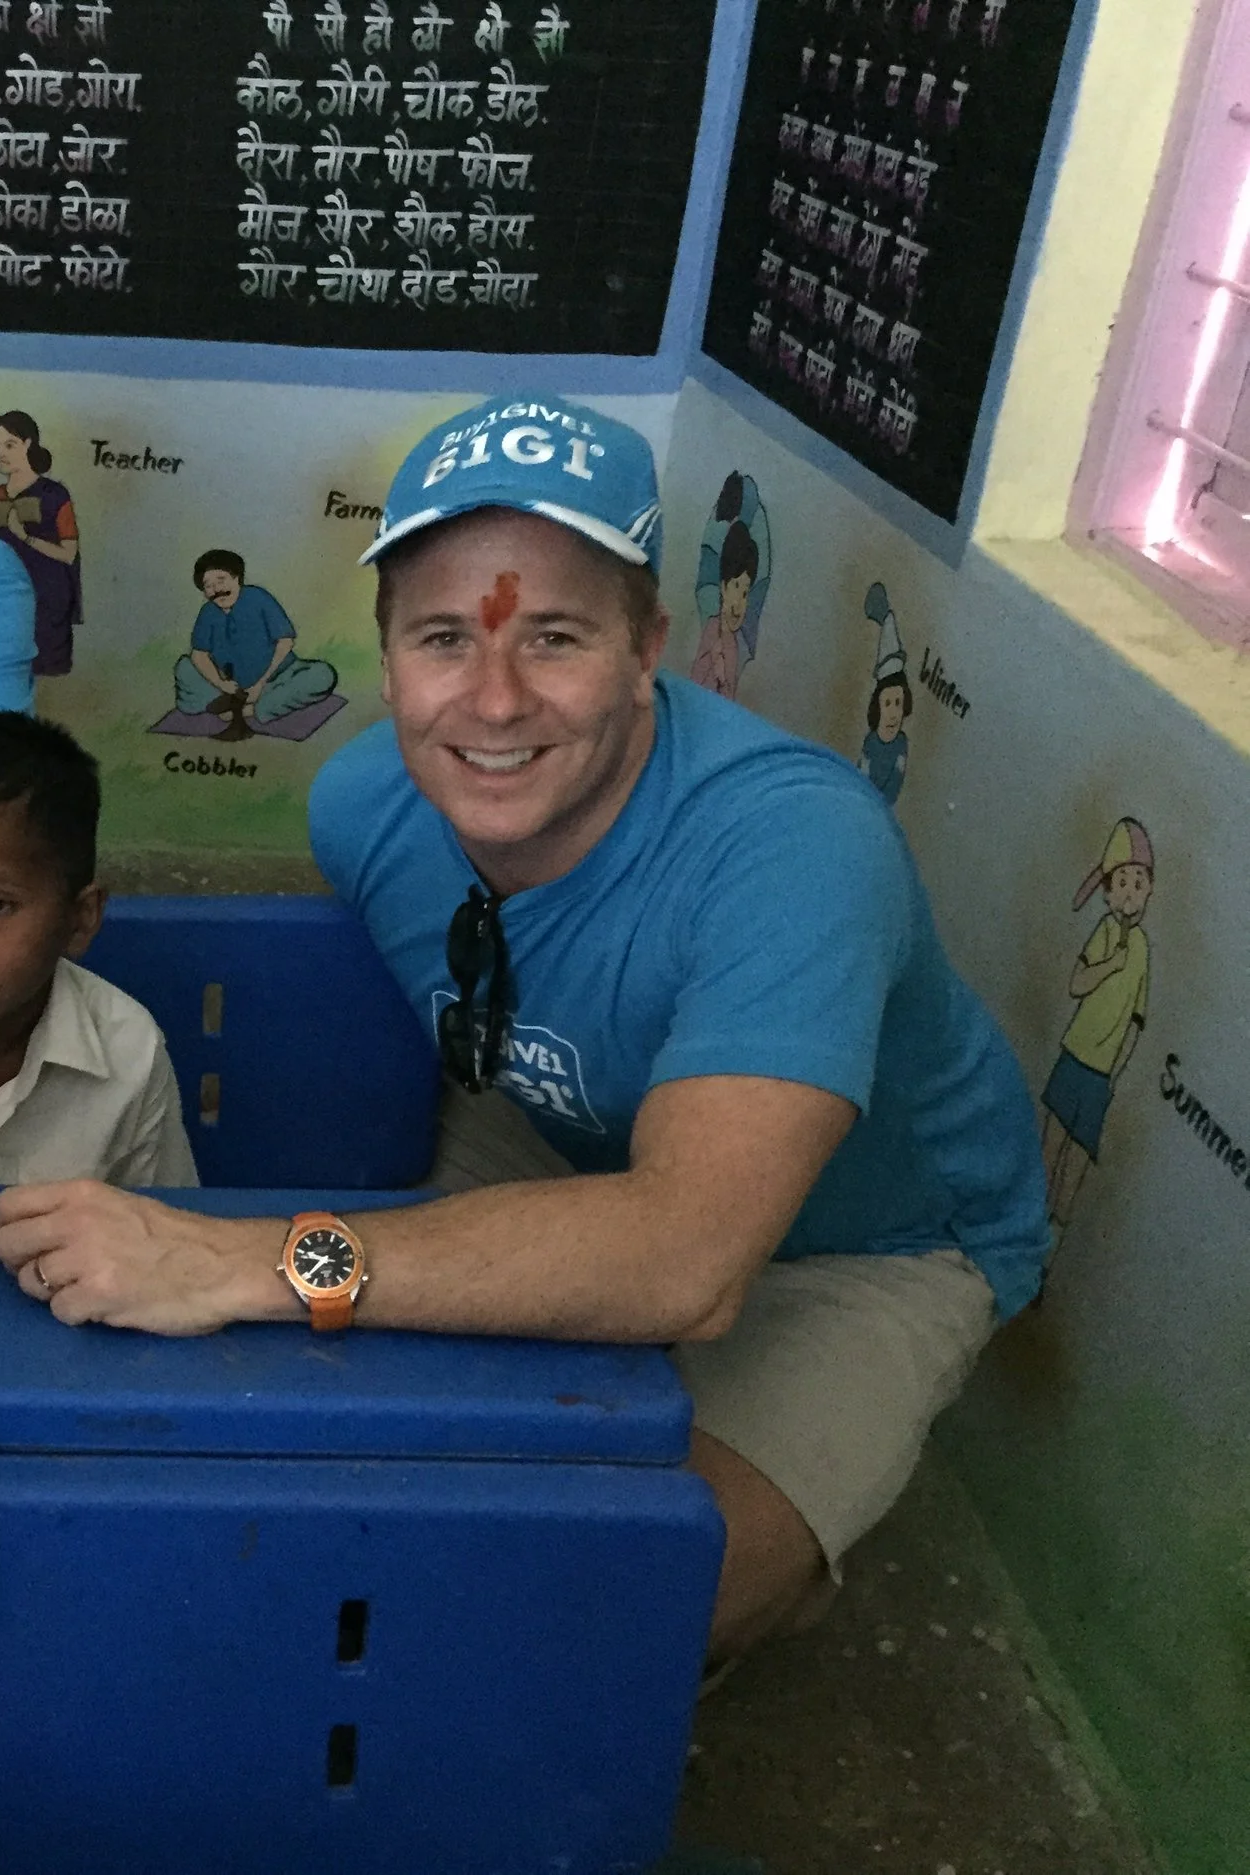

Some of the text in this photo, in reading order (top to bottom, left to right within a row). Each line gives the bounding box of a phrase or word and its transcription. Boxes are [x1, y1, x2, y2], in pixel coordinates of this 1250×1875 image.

[91, 439, 185, 475] Teacher
[324, 490, 384, 521] Farm
[919, 647, 971, 720] Winter
[163, 751, 258, 778] Cobbler
[1160, 1053, 1250, 1191] Summe
